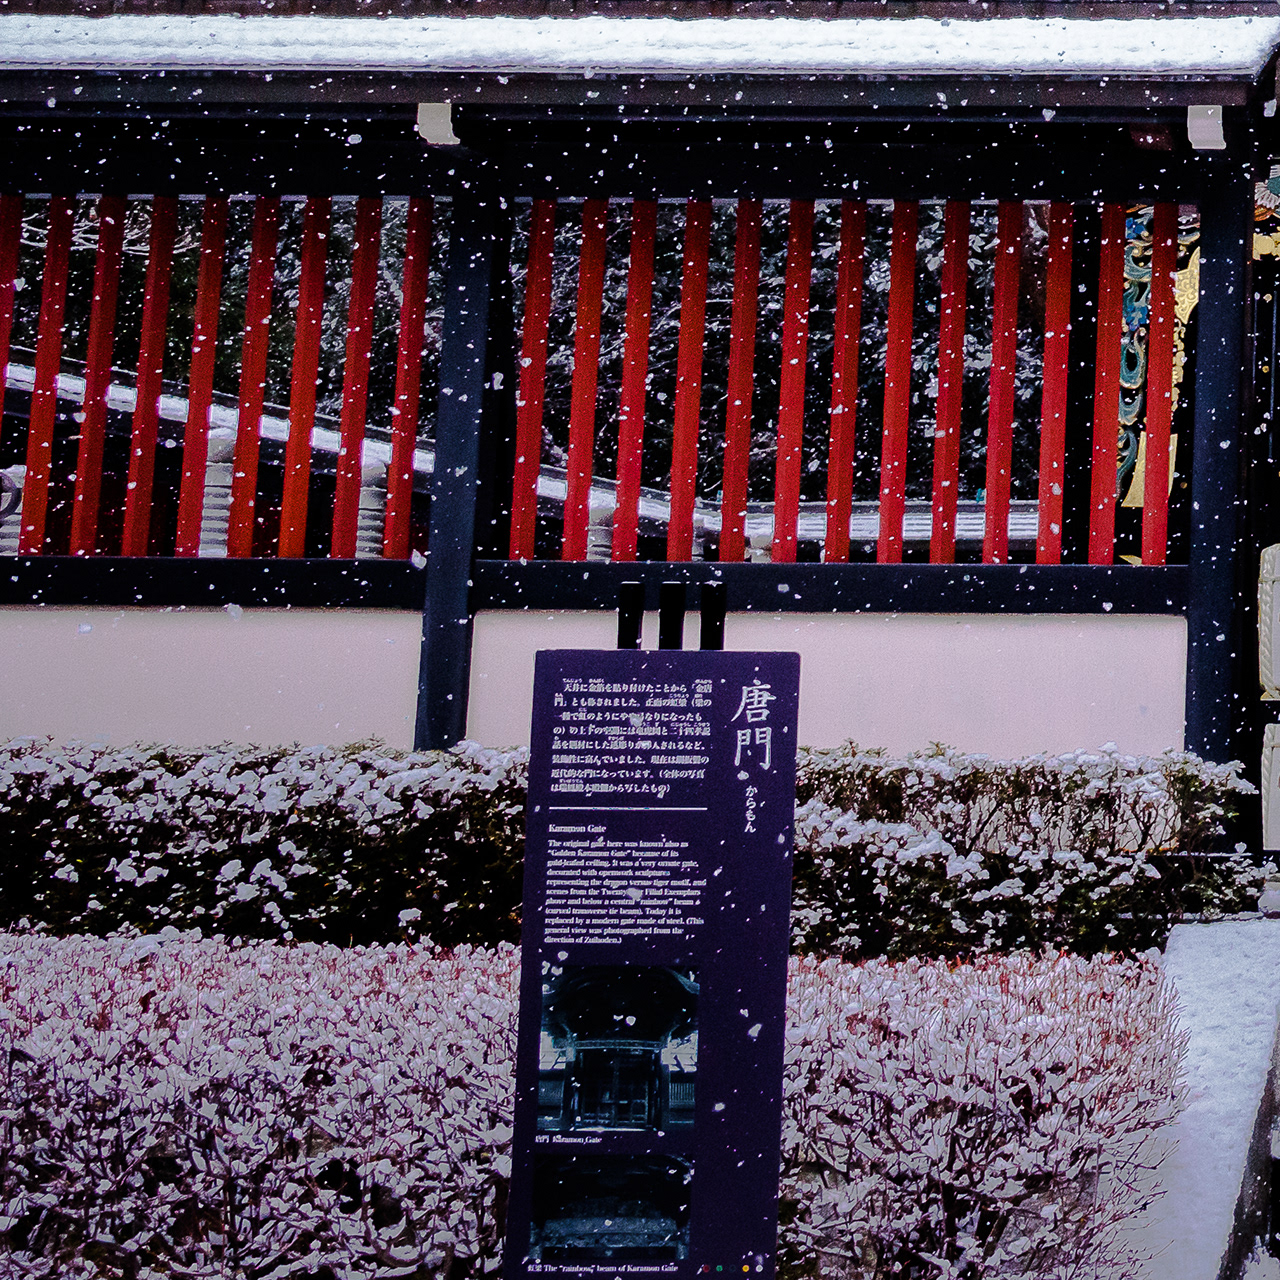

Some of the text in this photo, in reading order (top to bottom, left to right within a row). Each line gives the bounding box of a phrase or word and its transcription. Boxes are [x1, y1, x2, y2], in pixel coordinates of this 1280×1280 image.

[731, 680, 777, 770] 唐門
[744, 785, 757, 833] からもん
[549, 824, 606, 832] Karamon Gate
[544, 1264, 557, 1272] The
